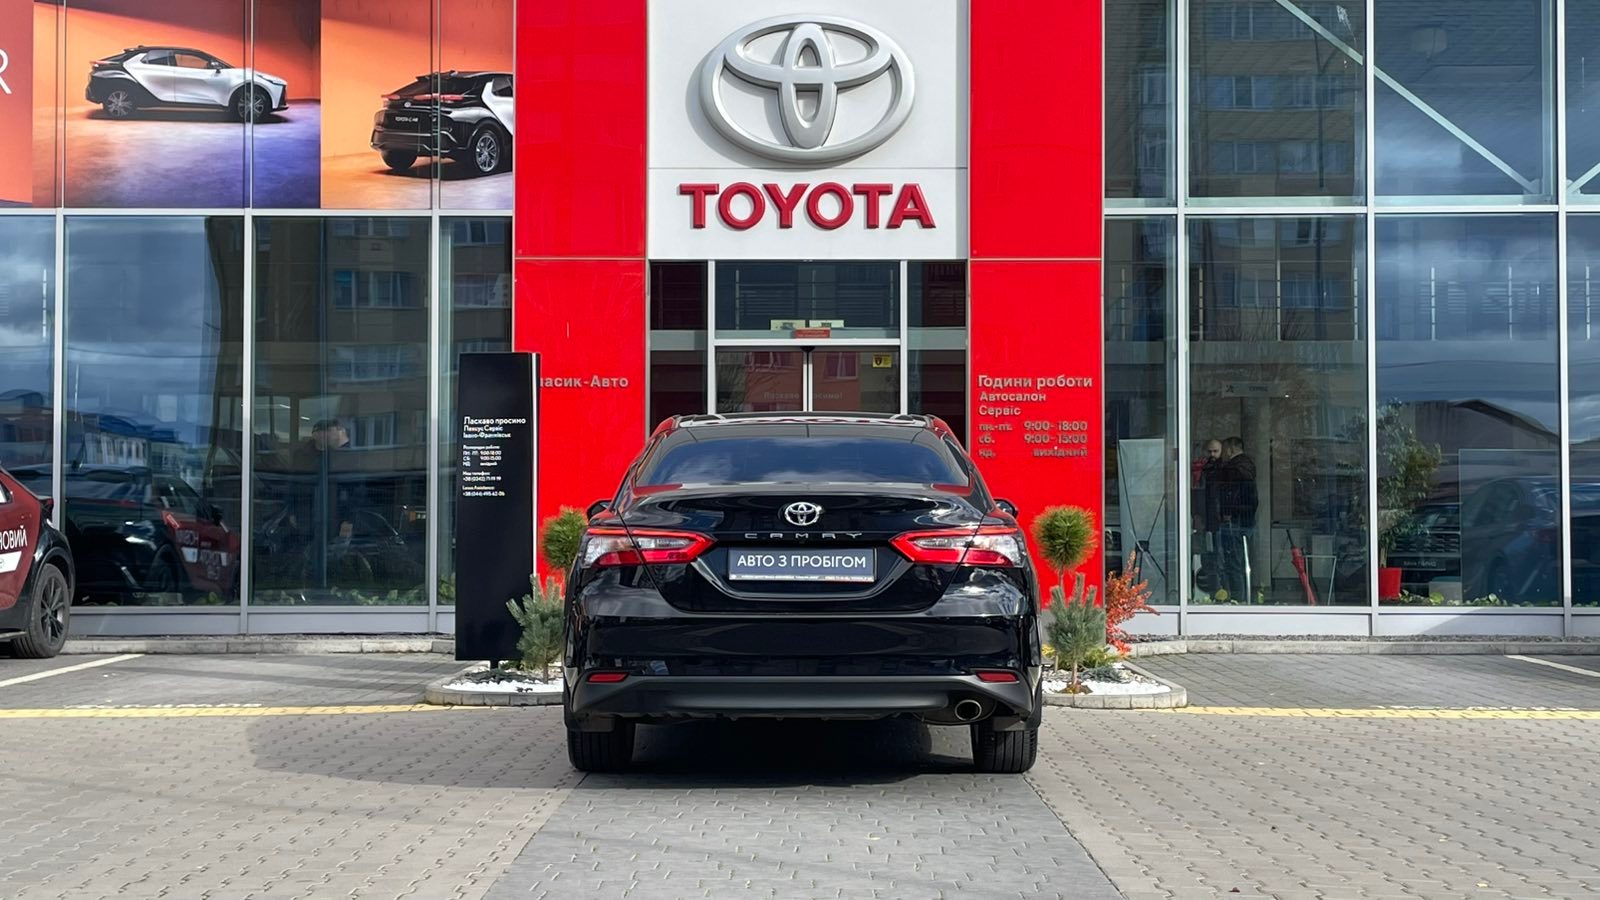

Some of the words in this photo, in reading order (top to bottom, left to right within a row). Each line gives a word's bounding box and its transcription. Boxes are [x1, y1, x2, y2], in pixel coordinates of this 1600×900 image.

[678, 182, 936, 230] TOYOTA
[540, 375, 628, 388] асик-Авто
[978, 375, 1032, 388] Години
[1036, 375, 1092, 390] роботи
[979, 392, 1046, 401] Автосалон
[978, 405, 1021, 417] Сервіс
[978, 434, 995, 443] сб.
[1033, 446, 1088, 457] вихідний
[737, 555, 774, 568] АВТО
[778, 555, 787, 567] З
[791, 555, 866, 568] ПРОБІГОМ
